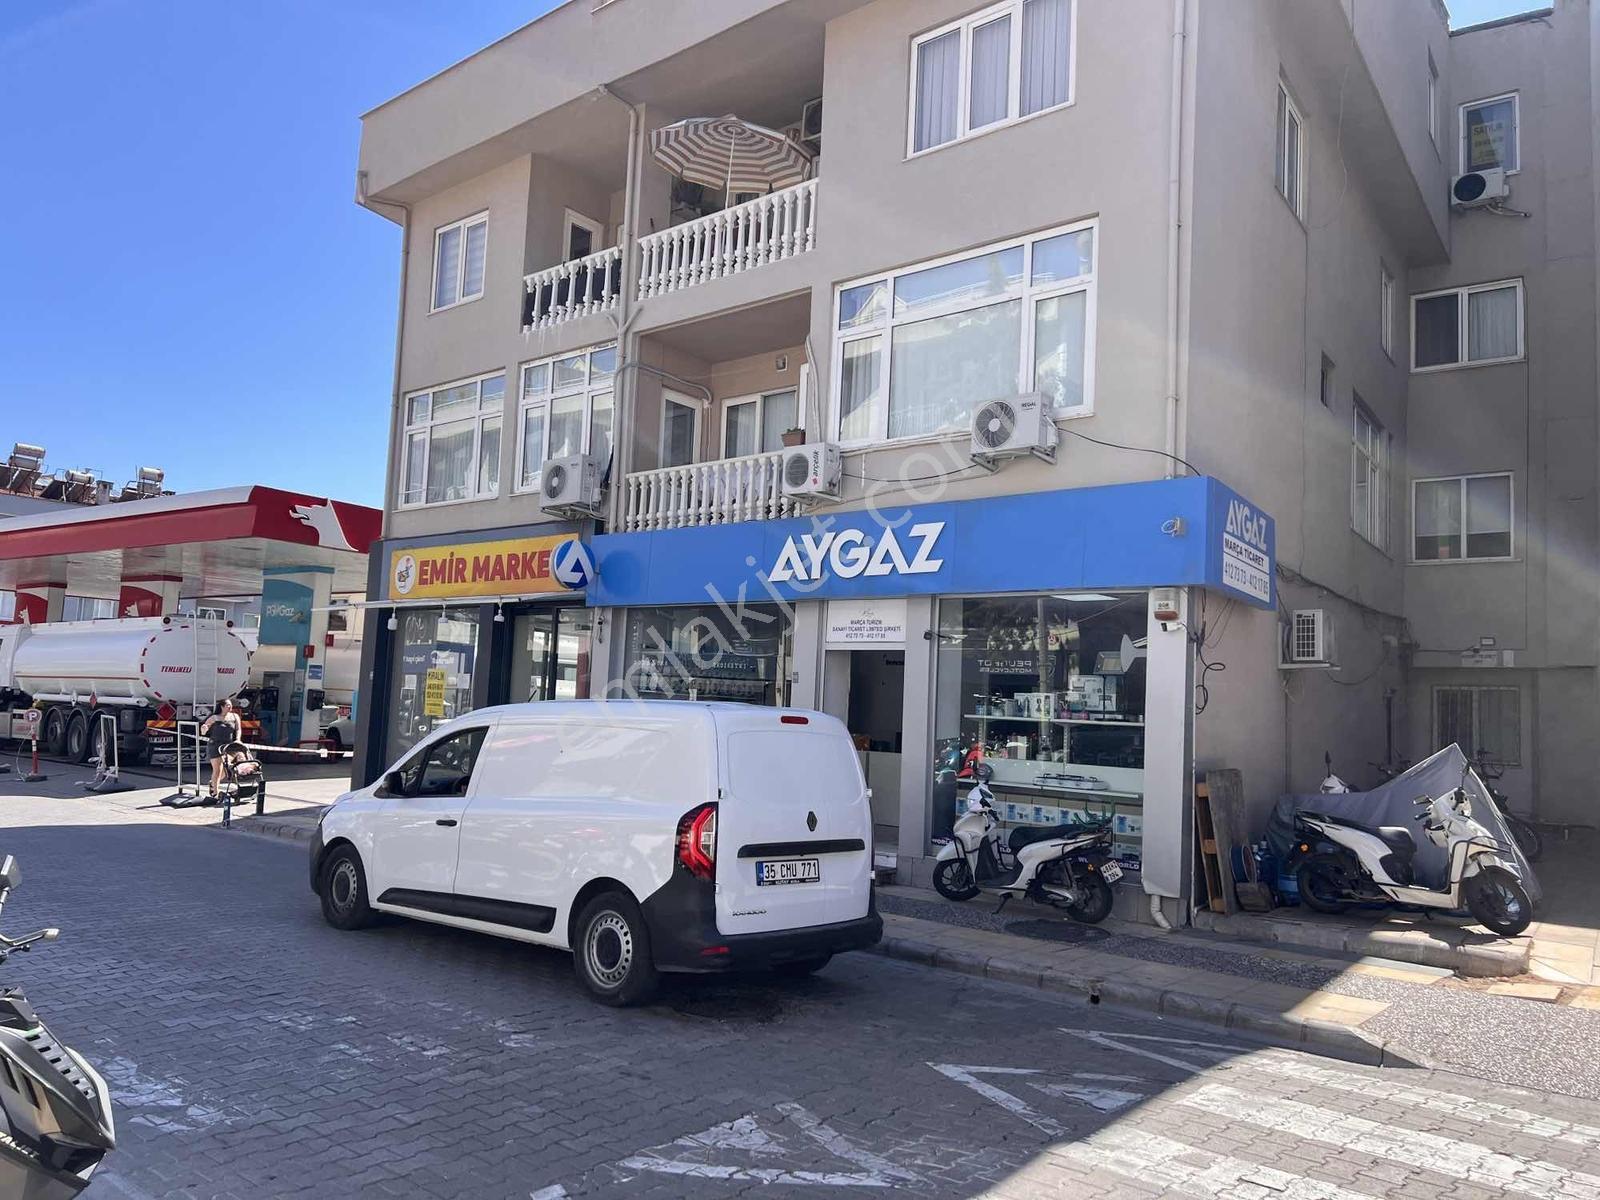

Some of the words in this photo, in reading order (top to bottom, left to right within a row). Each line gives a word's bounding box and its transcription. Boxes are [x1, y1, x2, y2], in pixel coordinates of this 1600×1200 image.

[1225, 499, 1267, 552] AYGAZ
[418, 551, 467, 586] EMİR
[471, 550, 551, 583] MARKE
[768, 521, 946, 582] AYGAZ
[764, 864, 776, 879] 35
[801, 862, 817, 877] 771
[1118, 862, 1140, 870] ORLD
